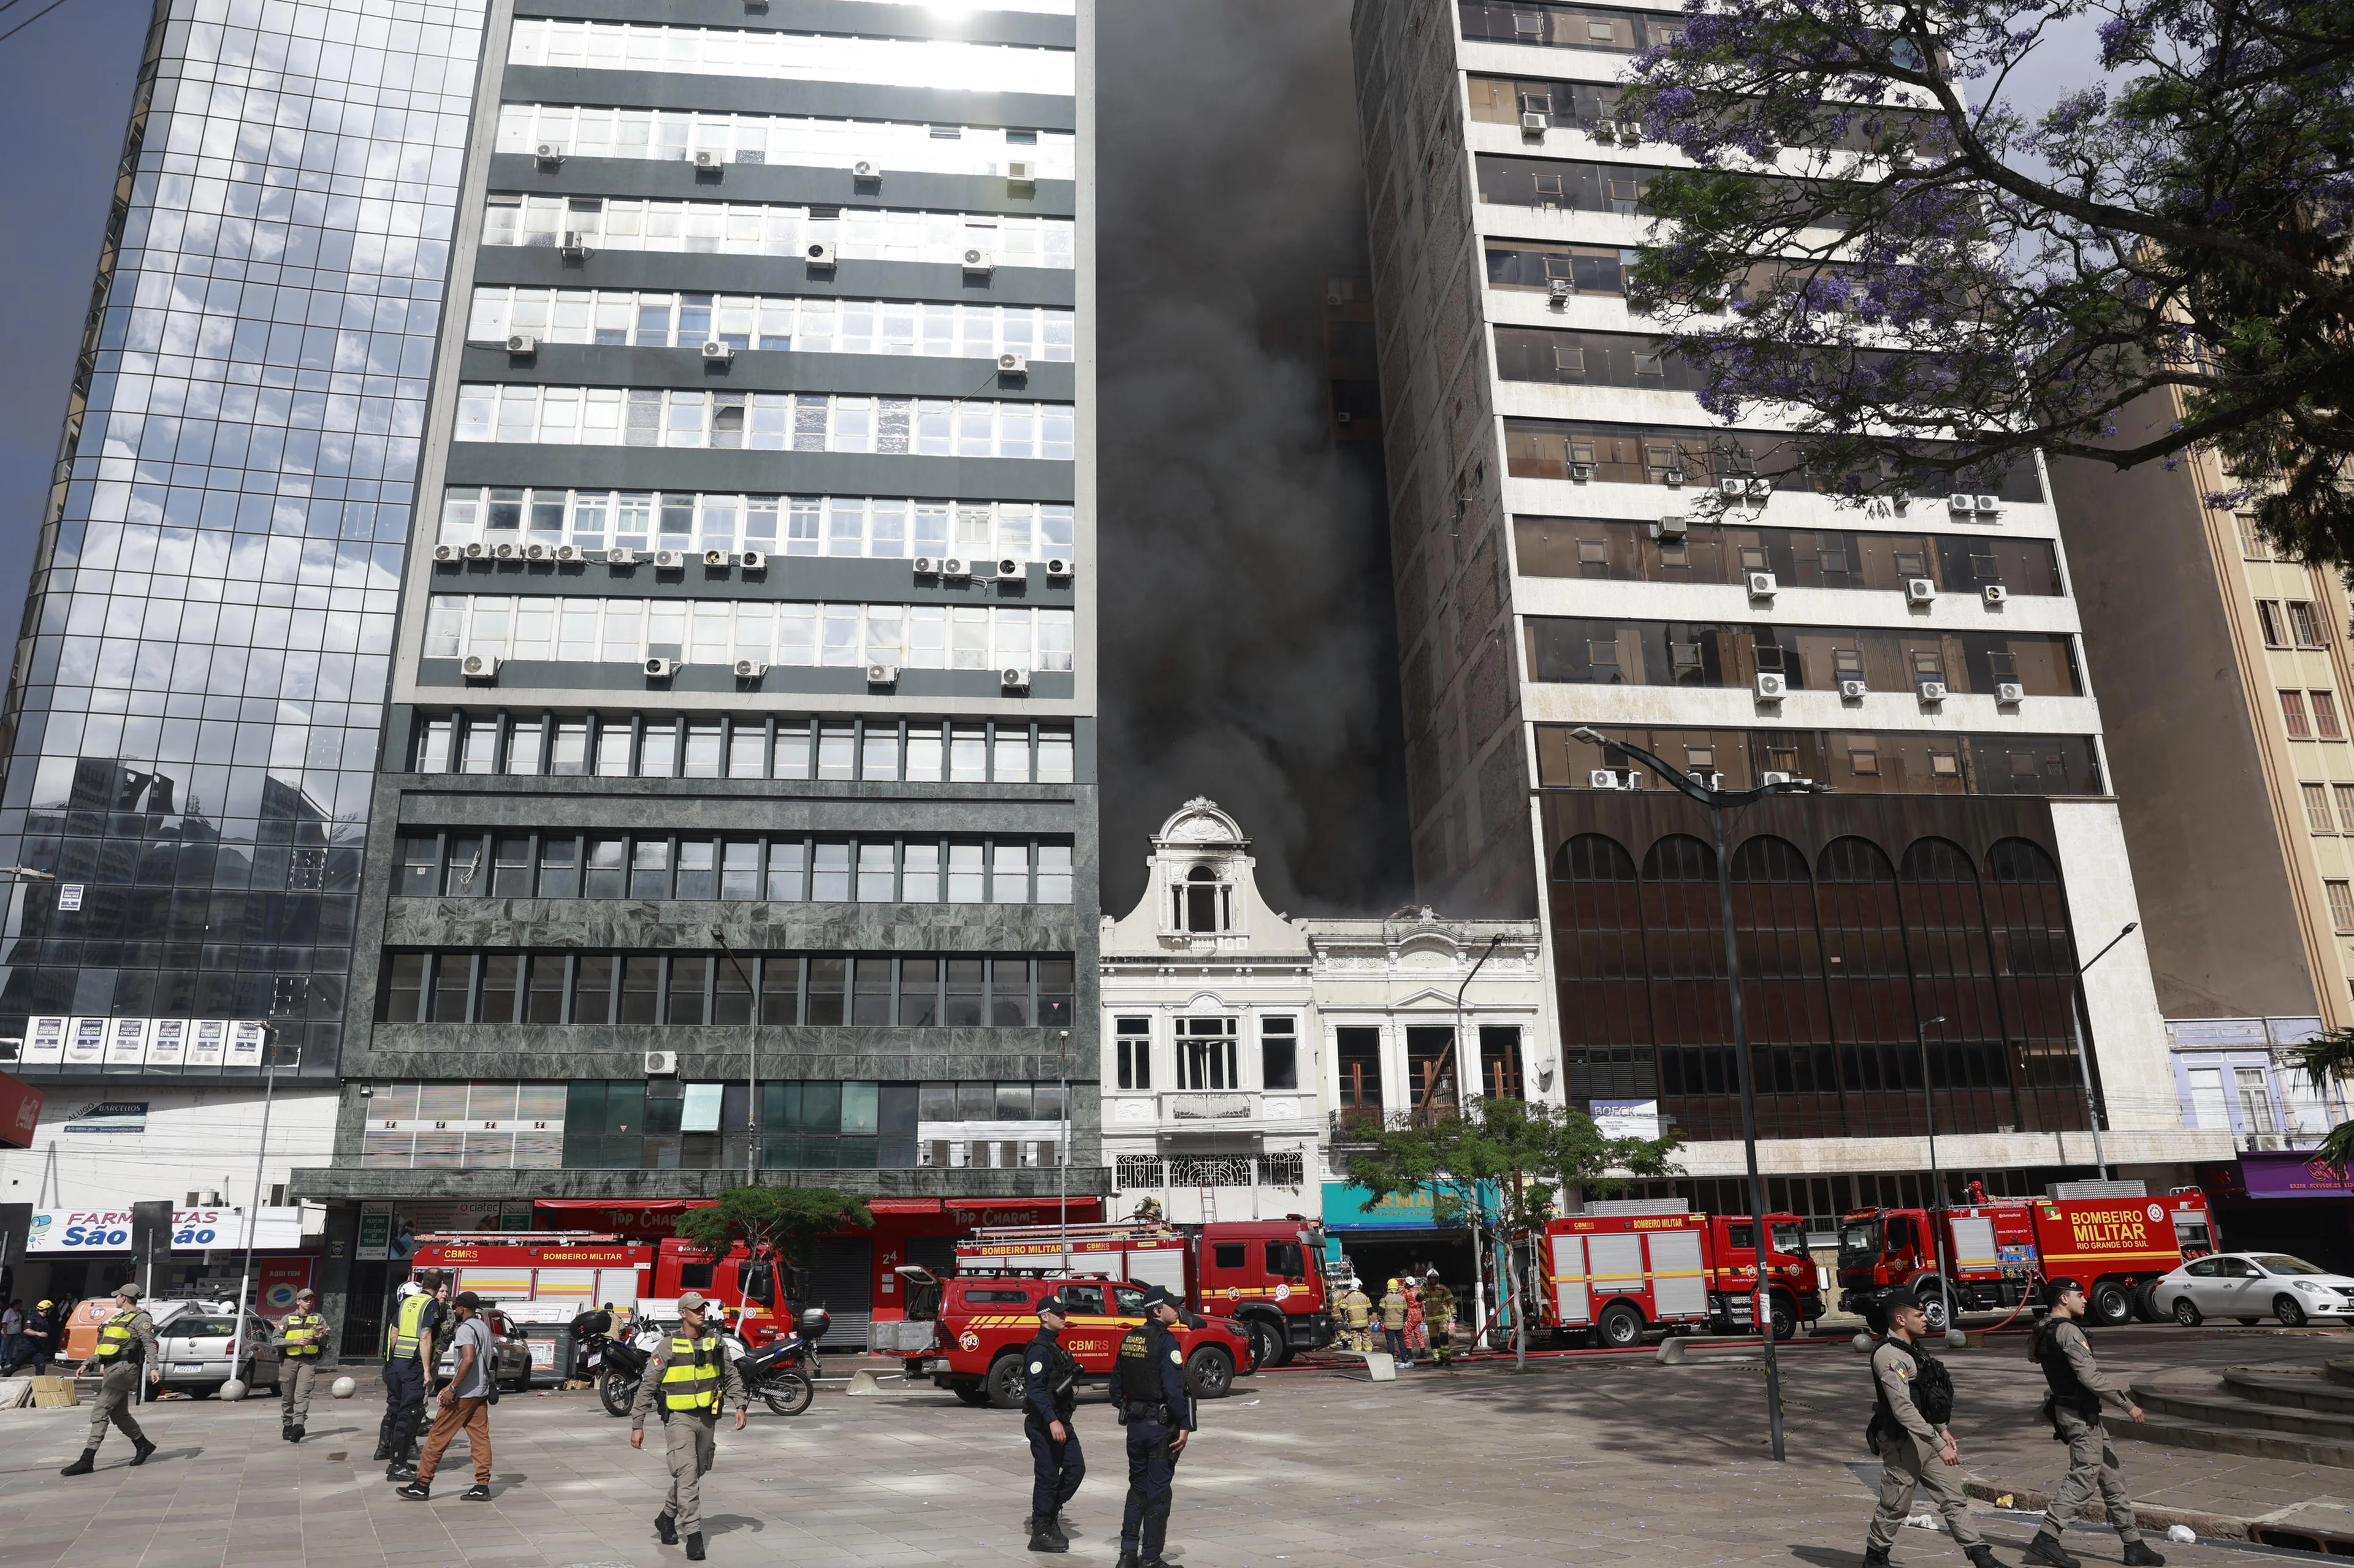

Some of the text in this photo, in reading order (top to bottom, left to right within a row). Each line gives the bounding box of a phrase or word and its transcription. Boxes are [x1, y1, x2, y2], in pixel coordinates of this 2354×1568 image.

[67, 1102, 94, 1122] ALUGO
[1594, 1106, 1636, 1117] BOECK
[470, 1203, 498, 1212] ciatec
[67, 1211, 218, 1225] FARMIAS
[2071, 1210, 2143, 1225] BOMBEIRO
[1633, 1219, 1683, 1228] BOMBEIRO MILITAR
[61, 1225, 128, 1246] São
[2073, 1224, 2147, 1242] MILITAR
[444, 1250, 478, 1258] CBMRS
[982, 1244, 1062, 1255] BOMBEIRO MILITAR
[883, 1250, 897, 1264] 24
[962, 1336, 978, 1346] 193
[1068, 1340, 1109, 1350] CBMRS
[1126, 1336, 1145, 1344] GUARDA
[1121, 1343, 1148, 1352] MUNICIPAL
